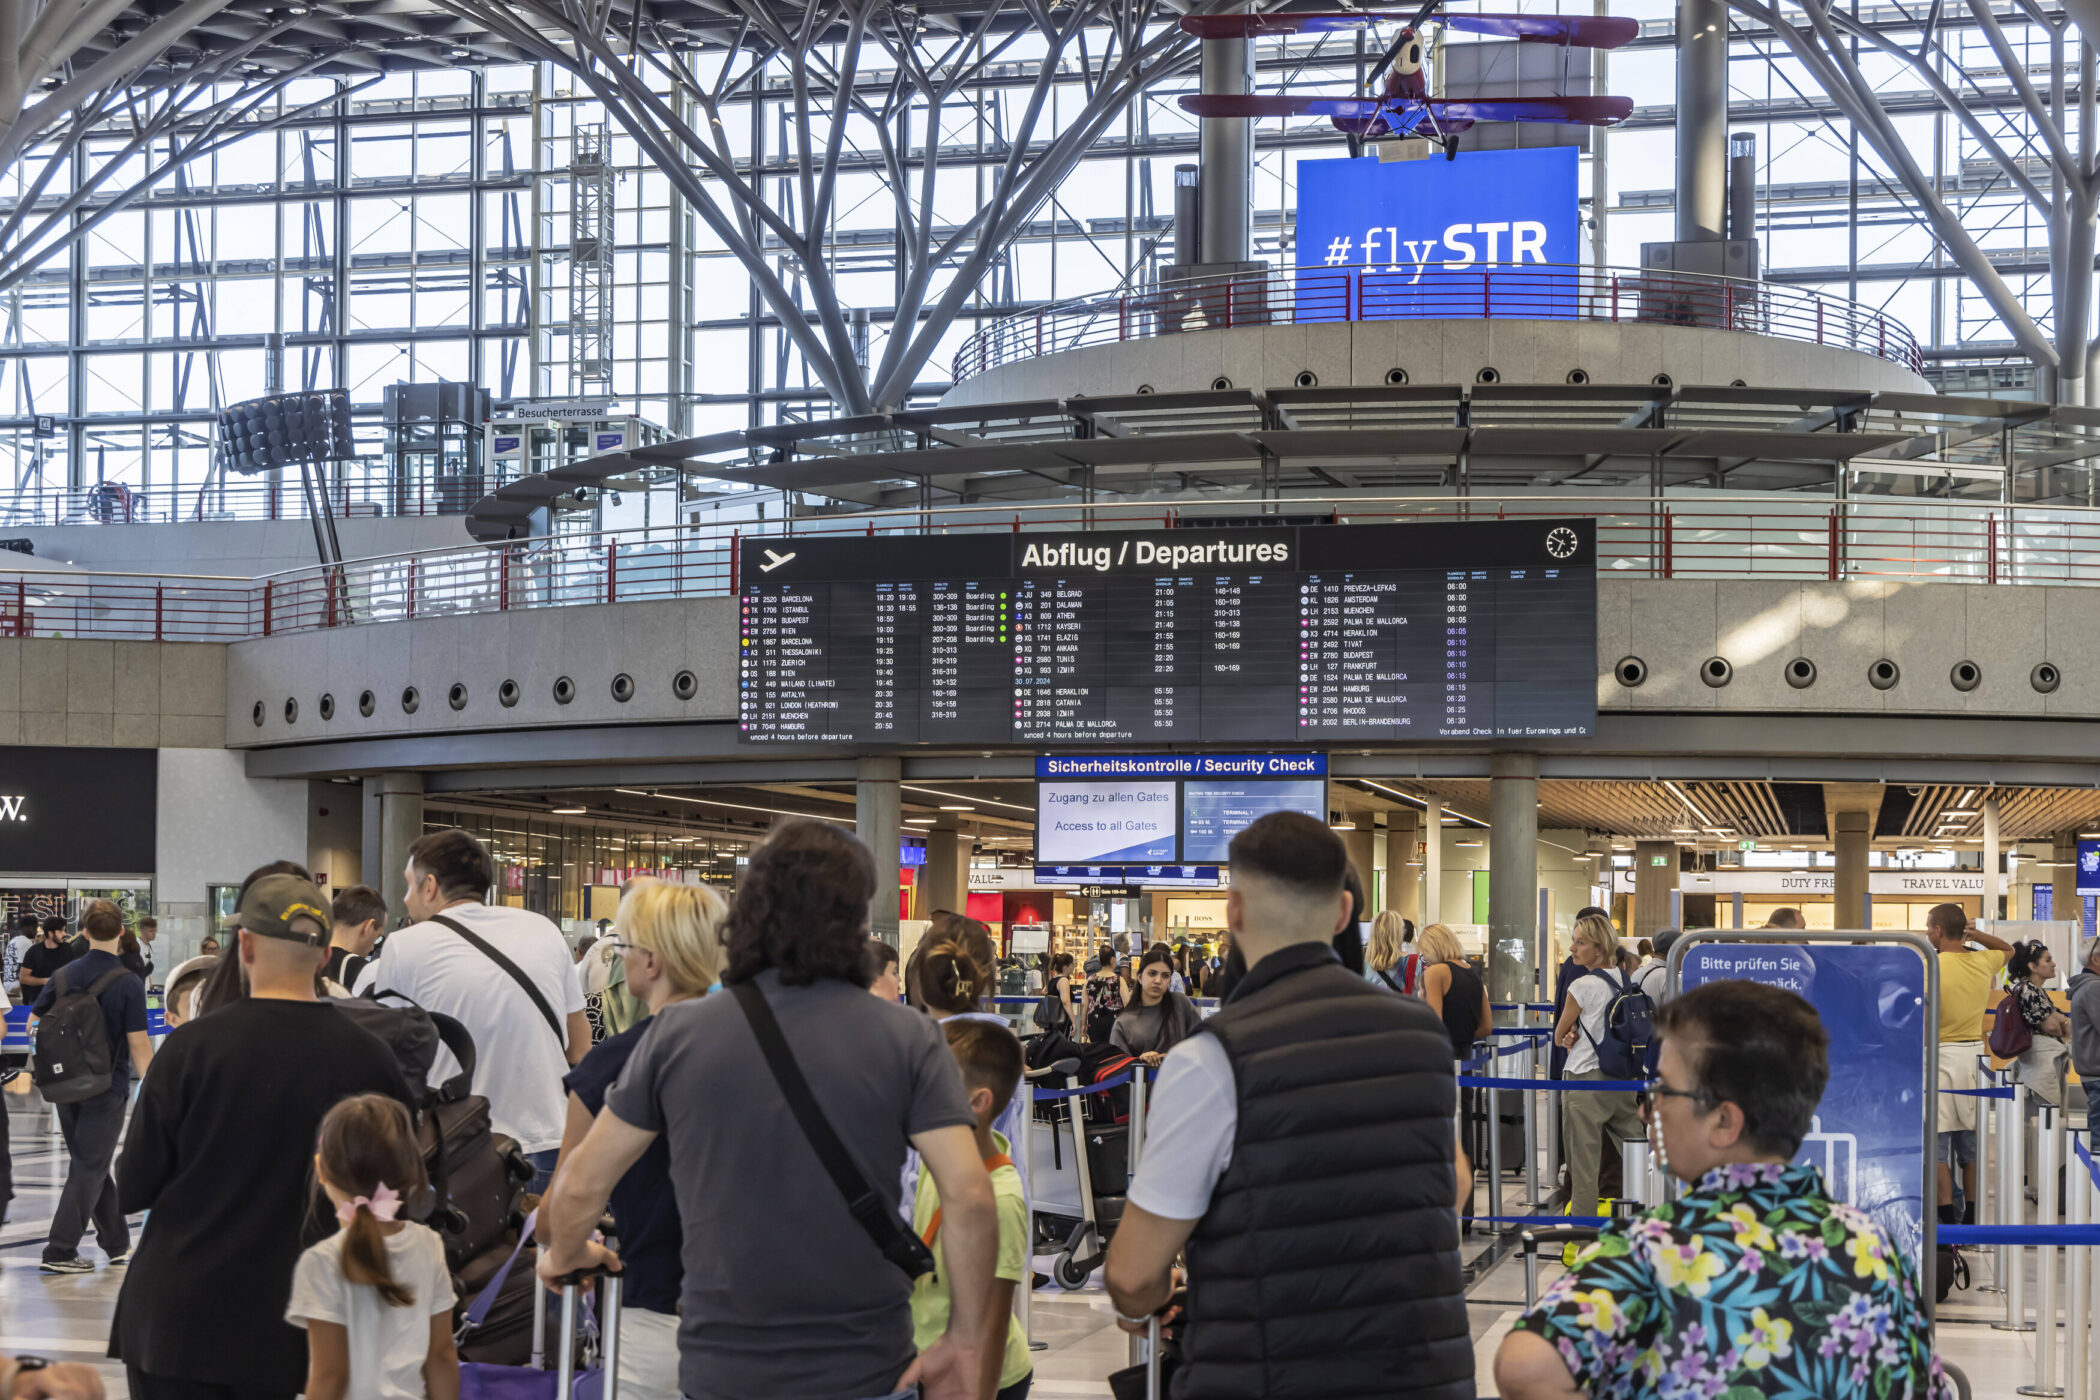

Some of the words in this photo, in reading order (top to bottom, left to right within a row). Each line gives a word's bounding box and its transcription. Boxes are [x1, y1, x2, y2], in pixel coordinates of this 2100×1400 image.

[1324, 221, 1547, 284] #flySTR
[518, 407, 603, 418] Besucherterrasse
[1022, 544, 1110, 570] Abflug
[1118, 541, 1129, 565] /
[1136, 541, 1288, 569] Departures
[1048, 760, 1192, 773] Sicherheitskontrolle
[1196, 760, 1201, 772] /
[1204, 760, 1264, 775] Security
[1269, 759, 1315, 771] Check
[1048, 792, 1089, 804] Zugang
[1092, 794, 1105, 802] zu
[1108, 792, 1133, 802] allen
[1137, 792, 1169, 802] Gates
[1055, 821, 1093, 831] Access
[1096, 821, 1107, 831] to
[1110, 820, 1123, 830] all
[1126, 820, 1157, 830] Gates
[1782, 879, 1811, 887] DUTY
[1903, 879, 1949, 888] TRAVEL
[1701, 957, 1731, 969] Bitte
[1735, 958, 1776, 973] prüfen
[1781, 958, 1800, 970] Sie
